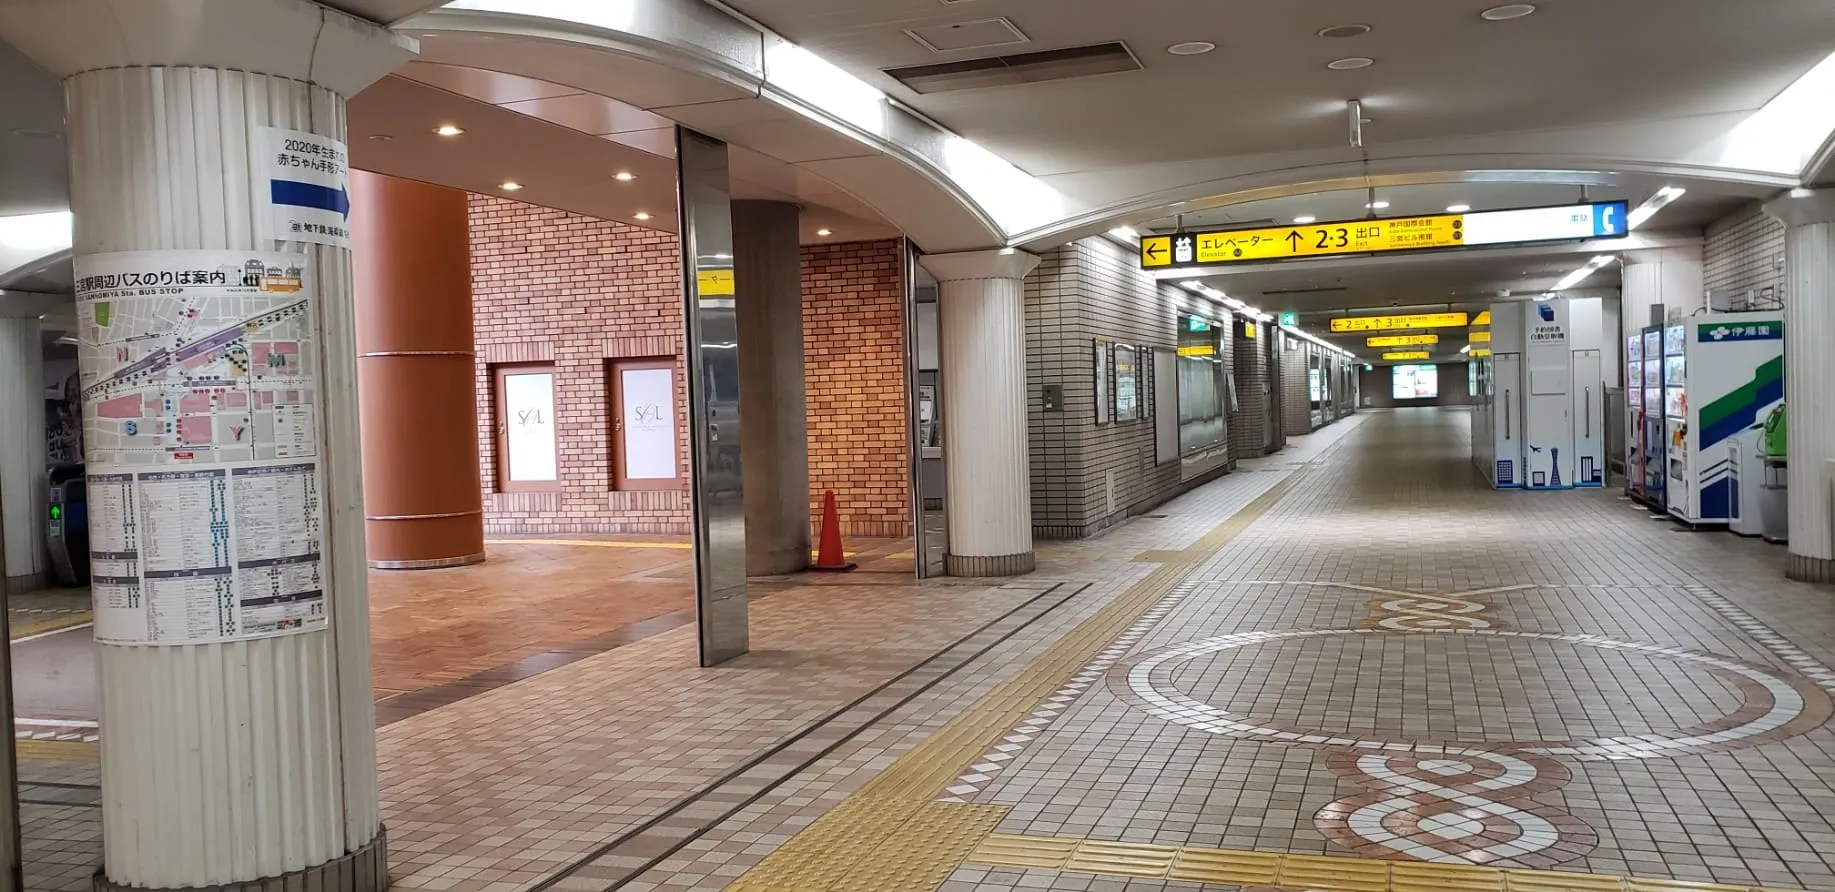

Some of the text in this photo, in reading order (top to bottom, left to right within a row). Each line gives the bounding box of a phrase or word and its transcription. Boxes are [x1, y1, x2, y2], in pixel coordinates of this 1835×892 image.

[1355, 226, 1380, 239] 出口
[1201, 235, 1274, 249] エレベーター
[1732, 325, 1770, 337] 伊藤園
